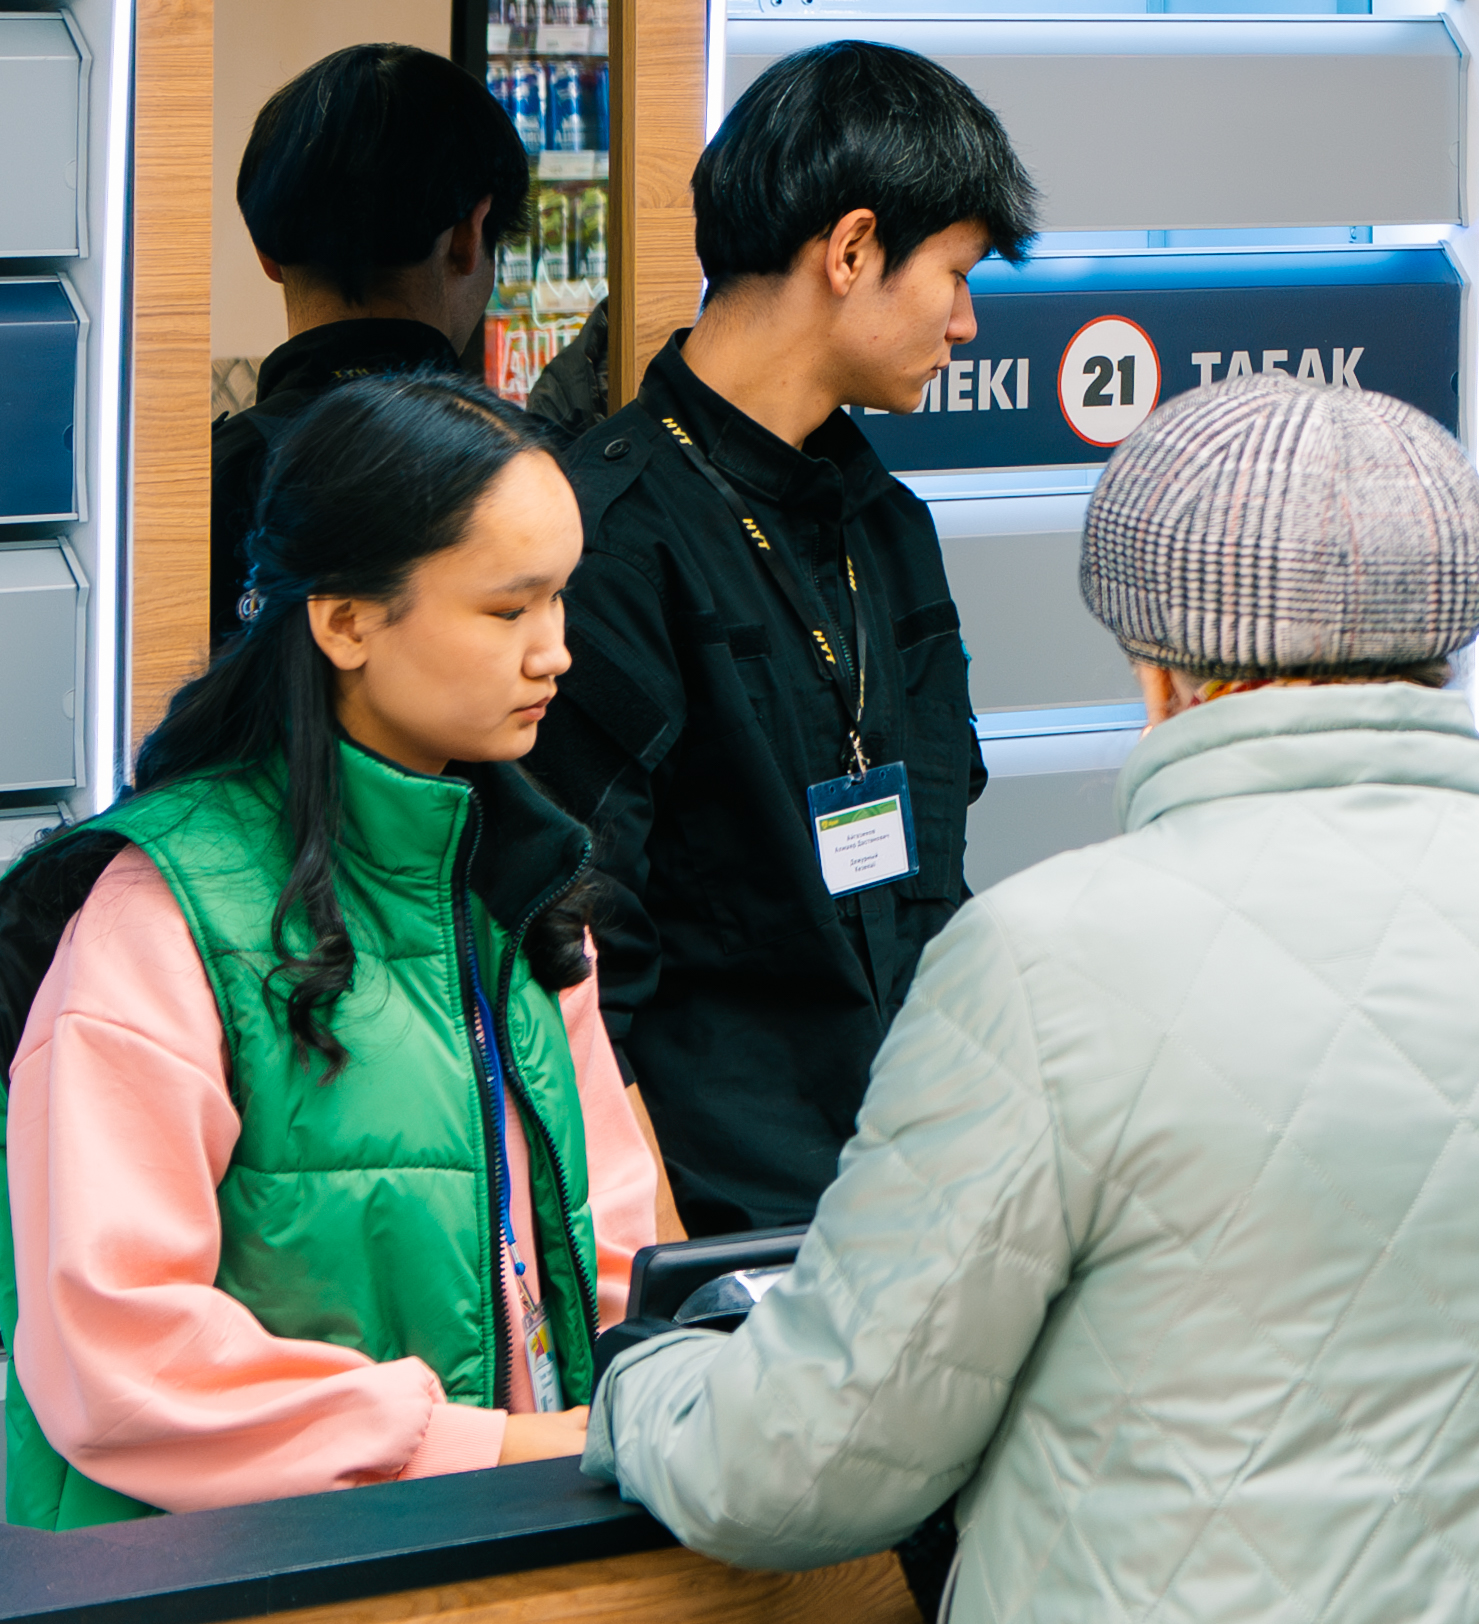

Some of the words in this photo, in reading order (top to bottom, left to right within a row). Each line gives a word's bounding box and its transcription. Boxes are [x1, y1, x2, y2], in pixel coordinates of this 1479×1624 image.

[1081, 354, 1136, 408] 21
[742, 517, 771, 550] HYT
[812, 629, 837, 665] HYT
